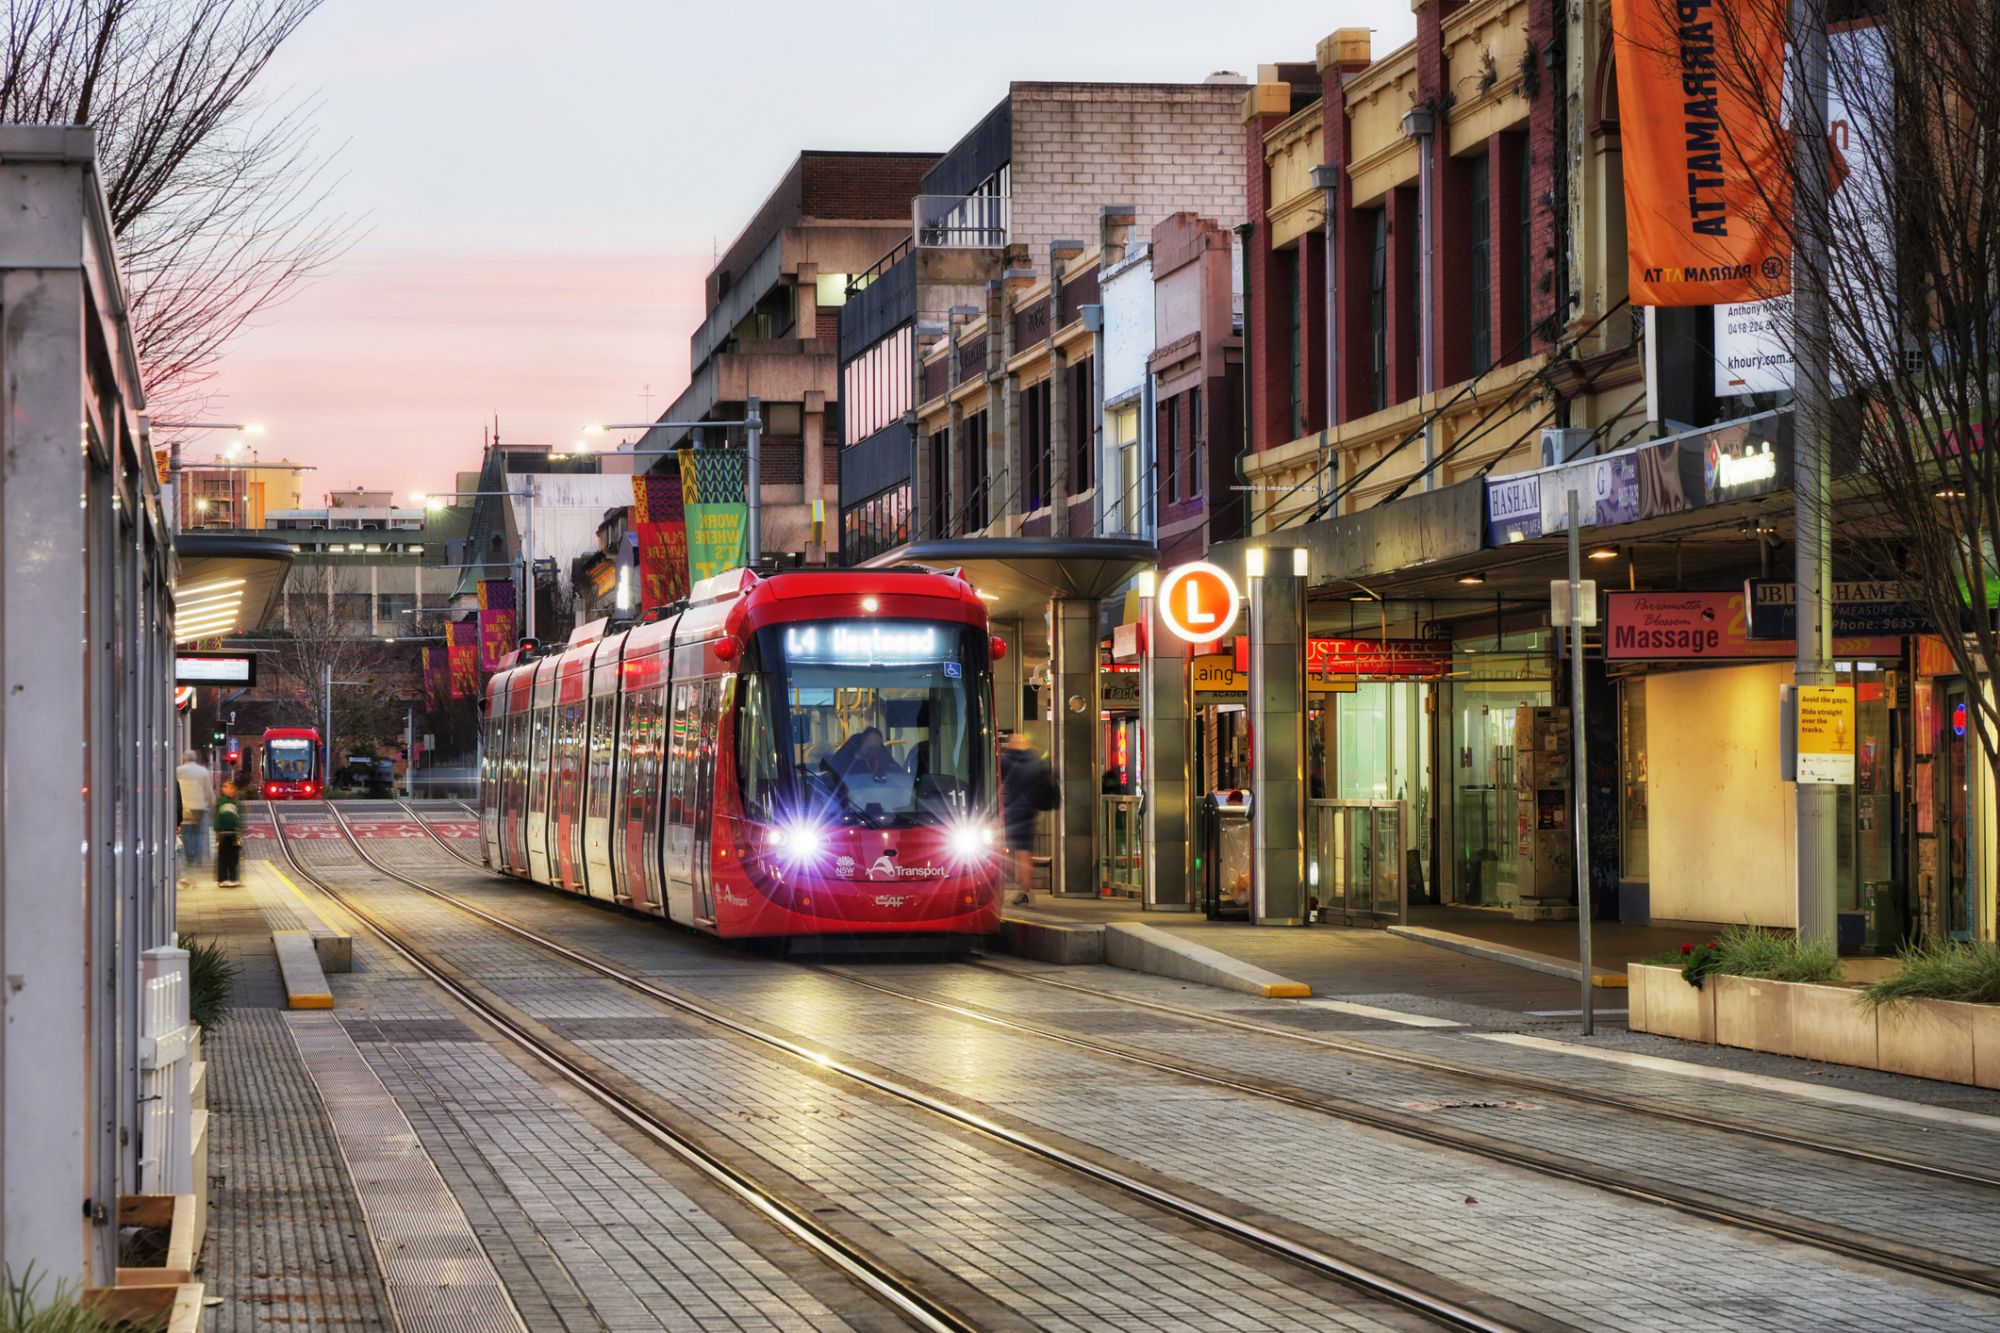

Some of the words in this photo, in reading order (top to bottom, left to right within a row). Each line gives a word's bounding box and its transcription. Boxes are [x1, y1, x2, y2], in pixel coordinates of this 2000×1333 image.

[1728, 304, 1760, 317] Anthony
[1491, 481, 1539, 517] HASHAM
[1186, 579, 1215, 623] L
[1759, 585, 1783, 603] JB
[1634, 599, 1702, 611] Parramatta
[1643, 613, 1692, 626] Blossom
[1615, 625, 1719, 653] Massage
[1195, 665, 1234, 685] aing
[1817, 708, 1843, 717] straight
[949, 789, 966, 807] 11
[836, 866, 855, 875] NSW
[895, 865, 946, 878] Transport
